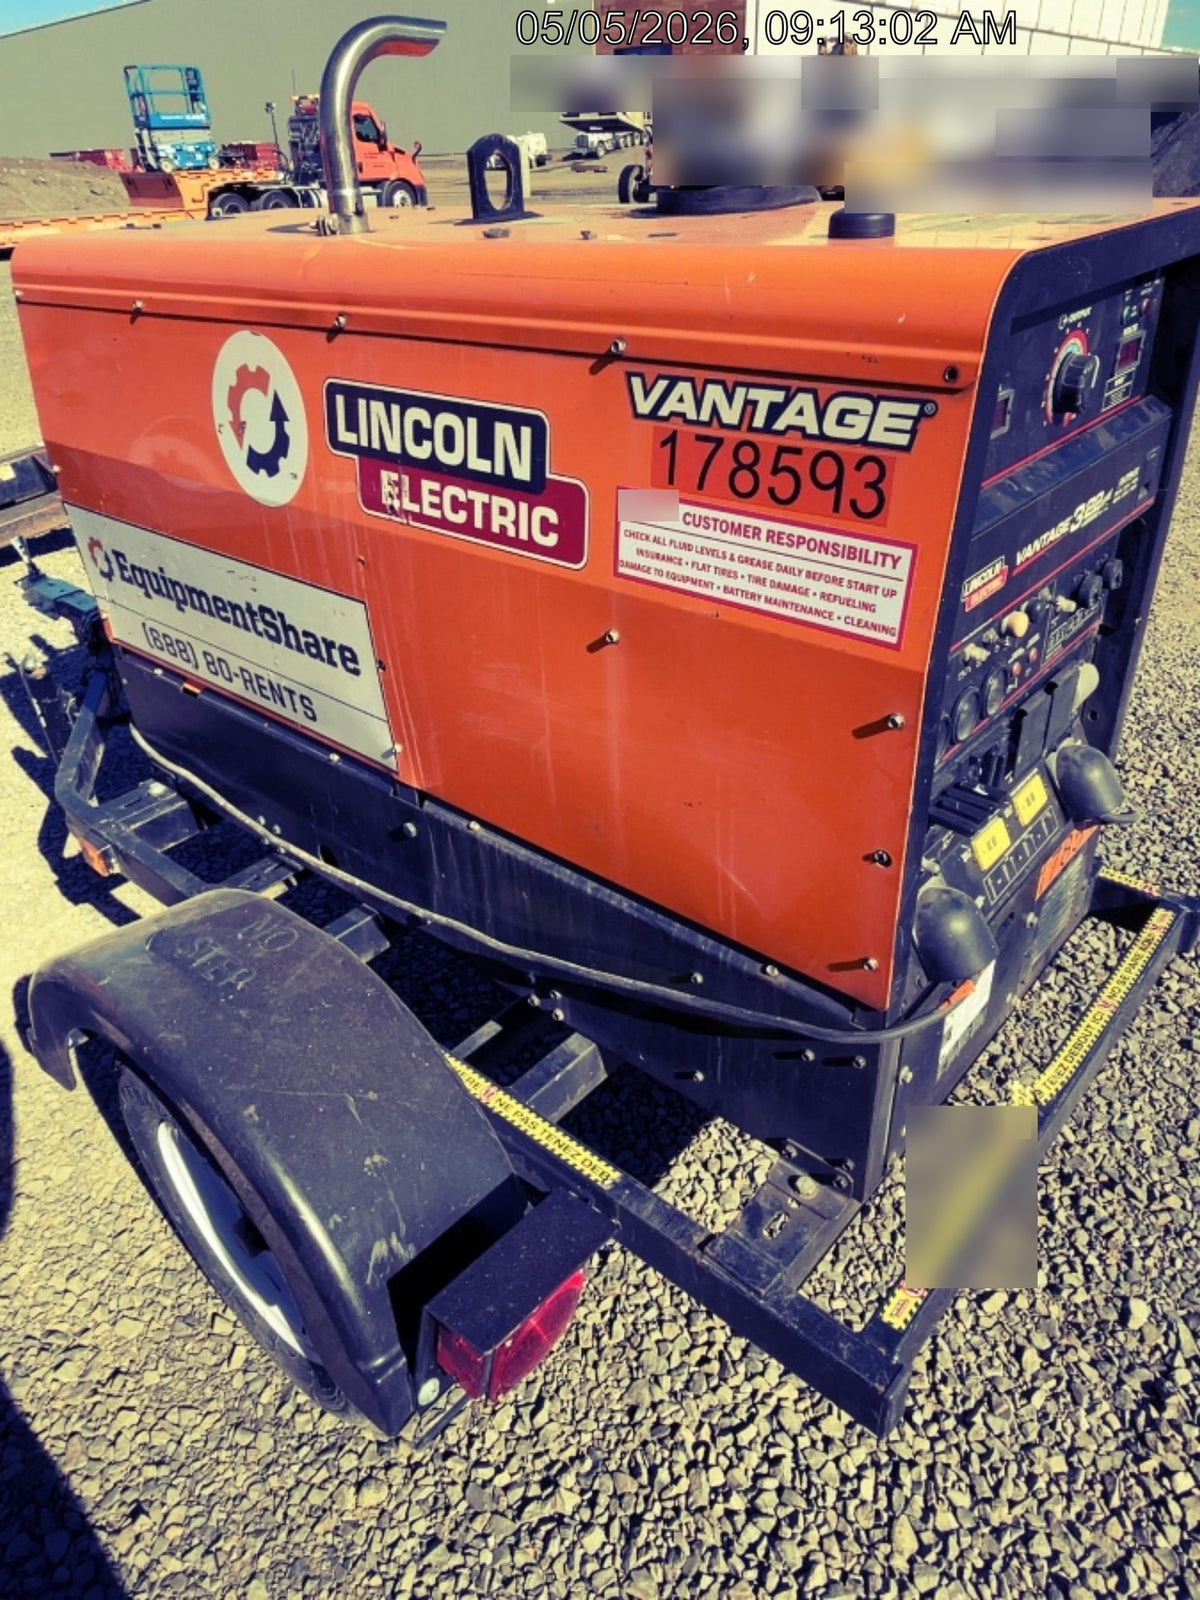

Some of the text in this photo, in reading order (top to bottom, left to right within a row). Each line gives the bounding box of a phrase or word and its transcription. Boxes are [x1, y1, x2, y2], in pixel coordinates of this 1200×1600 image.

[334, 393, 533, 483] LINCOLN
[629, 375, 920, 447] VANTAGE
[379, 468, 560, 548] ELECTRIC
[659, 428, 888, 521] 178593
[623, 529, 898, 599] CHECK ALL FLUID LEVELS & GREASE DAILY BEFORE START UP
[682, 511, 902, 570] CUSTOMER RESPONSIBILITY
[111, 548, 361, 677] EquipmentShare
[619, 559, 897, 638] DAMAGE TO EQUIPMENT BATTERY MAINTENANCE CLEANING
[636, 547, 877, 614] INSURANCE FLAT TIRES TIRE DAMAGE REFUELING
[202, 650, 318, 723] 80-RENTS
[513, 1106, 539, 1130] PAS
[540, 1124, 582, 1159] TENEZ
